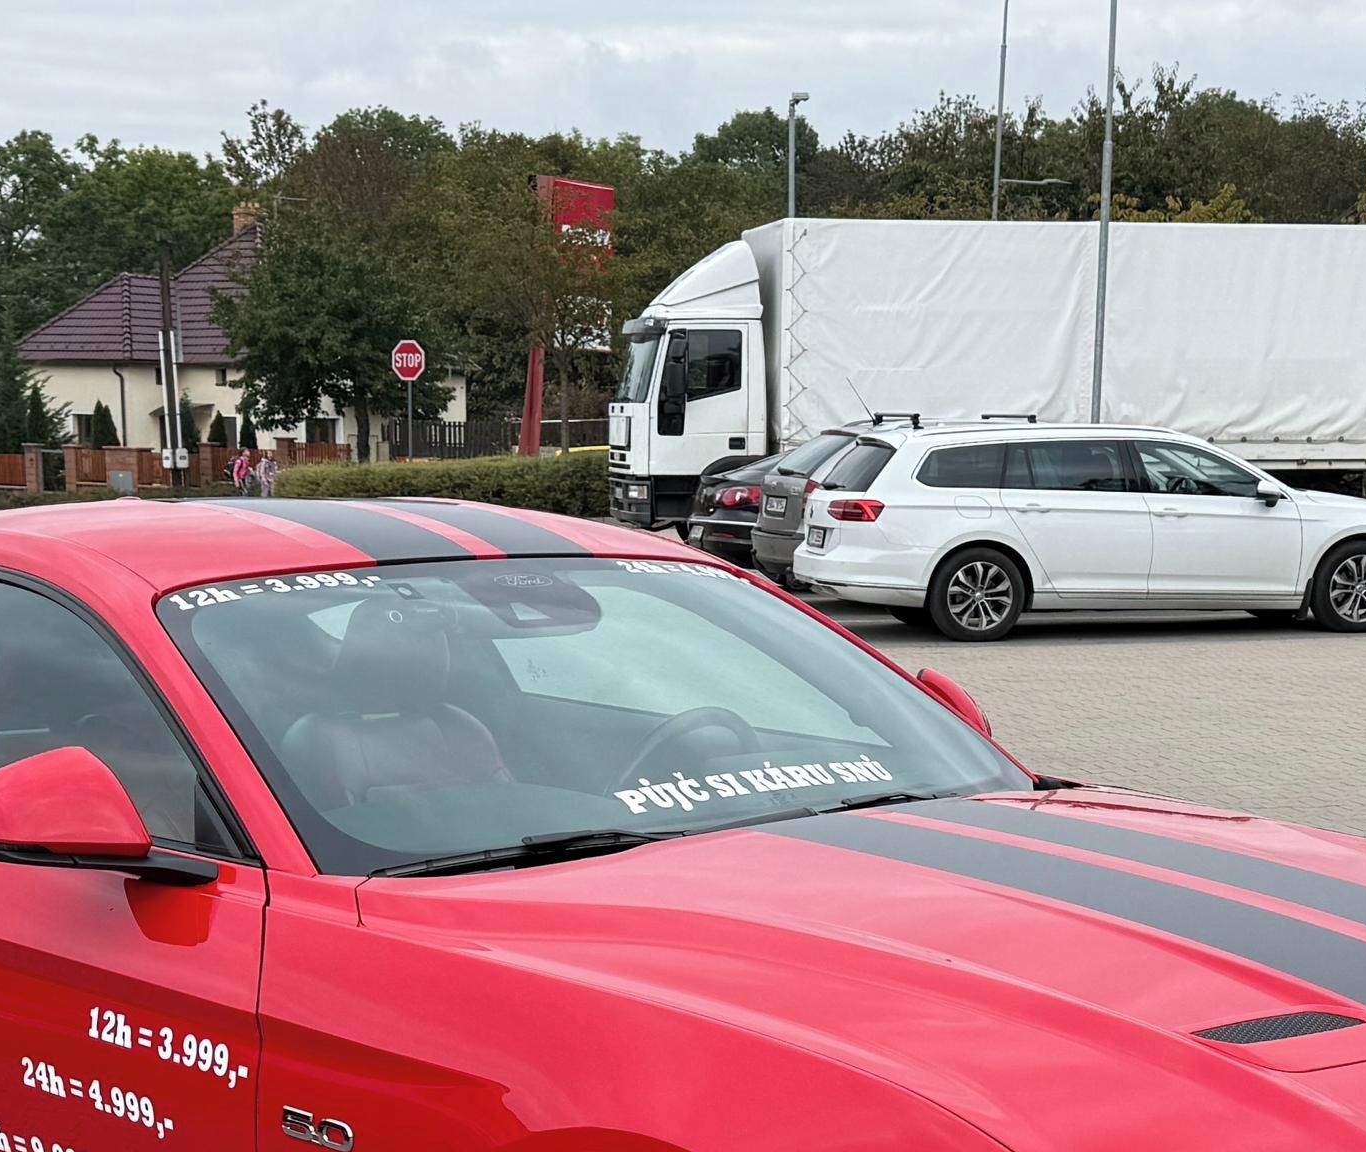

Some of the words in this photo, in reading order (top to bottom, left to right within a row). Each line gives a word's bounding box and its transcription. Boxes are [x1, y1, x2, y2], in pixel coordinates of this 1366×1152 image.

[395, 353, 421, 368] STOP
[169, 587, 242, 612] 12h
[264, 572, 382, 594] 3.999,-
[704, 773, 752, 798] SI
[738, 761, 836, 793] KÁRU
[88, 1006, 133, 1049] 12h
[157, 1026, 249, 1089] 3.999,-
[20, 1056, 67, 1098] 24h
[87, 1079, 175, 1139] 4.999,-
